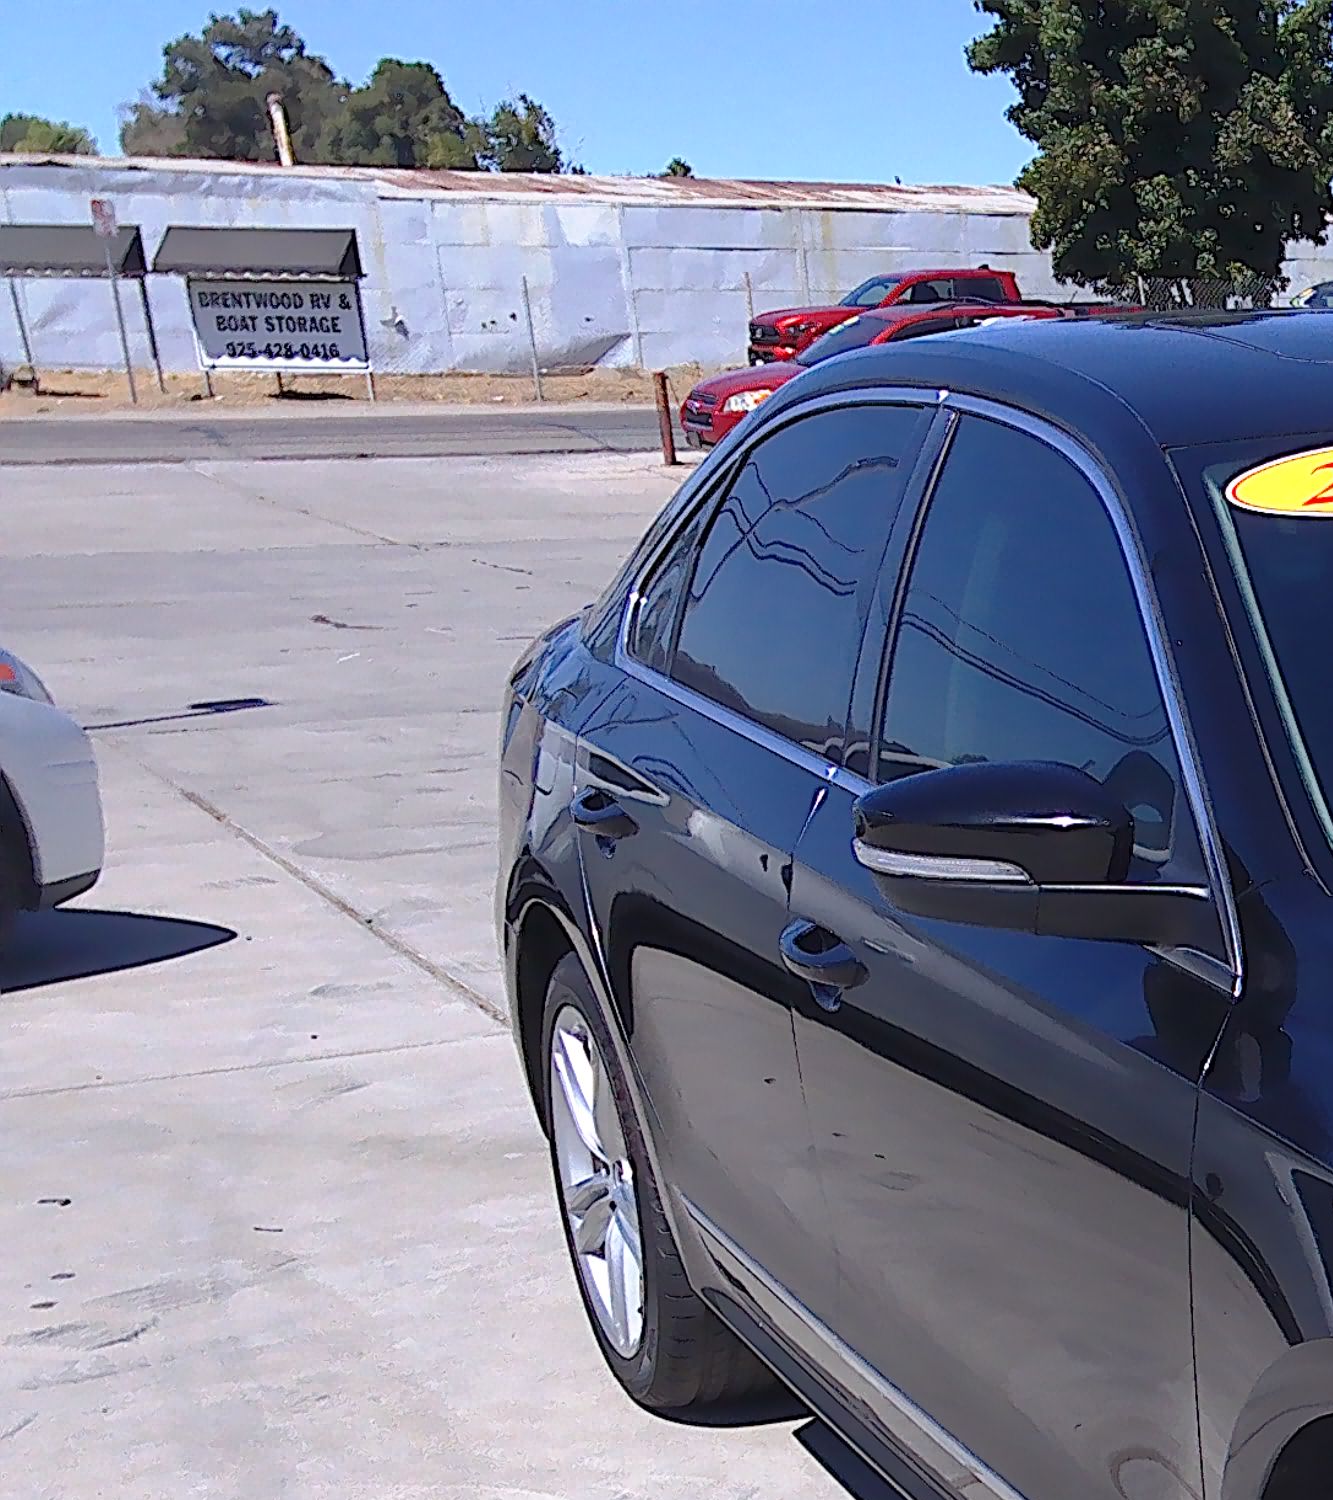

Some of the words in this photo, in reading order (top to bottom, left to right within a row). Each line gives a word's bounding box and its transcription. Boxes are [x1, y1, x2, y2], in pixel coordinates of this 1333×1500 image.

[198, 291, 304, 310] BRENTWOOD
[309, 292, 331, 310] RV
[338, 294, 352, 310] &
[215, 315, 258, 332] BOAT
[265, 316, 341, 333] STORAGE
